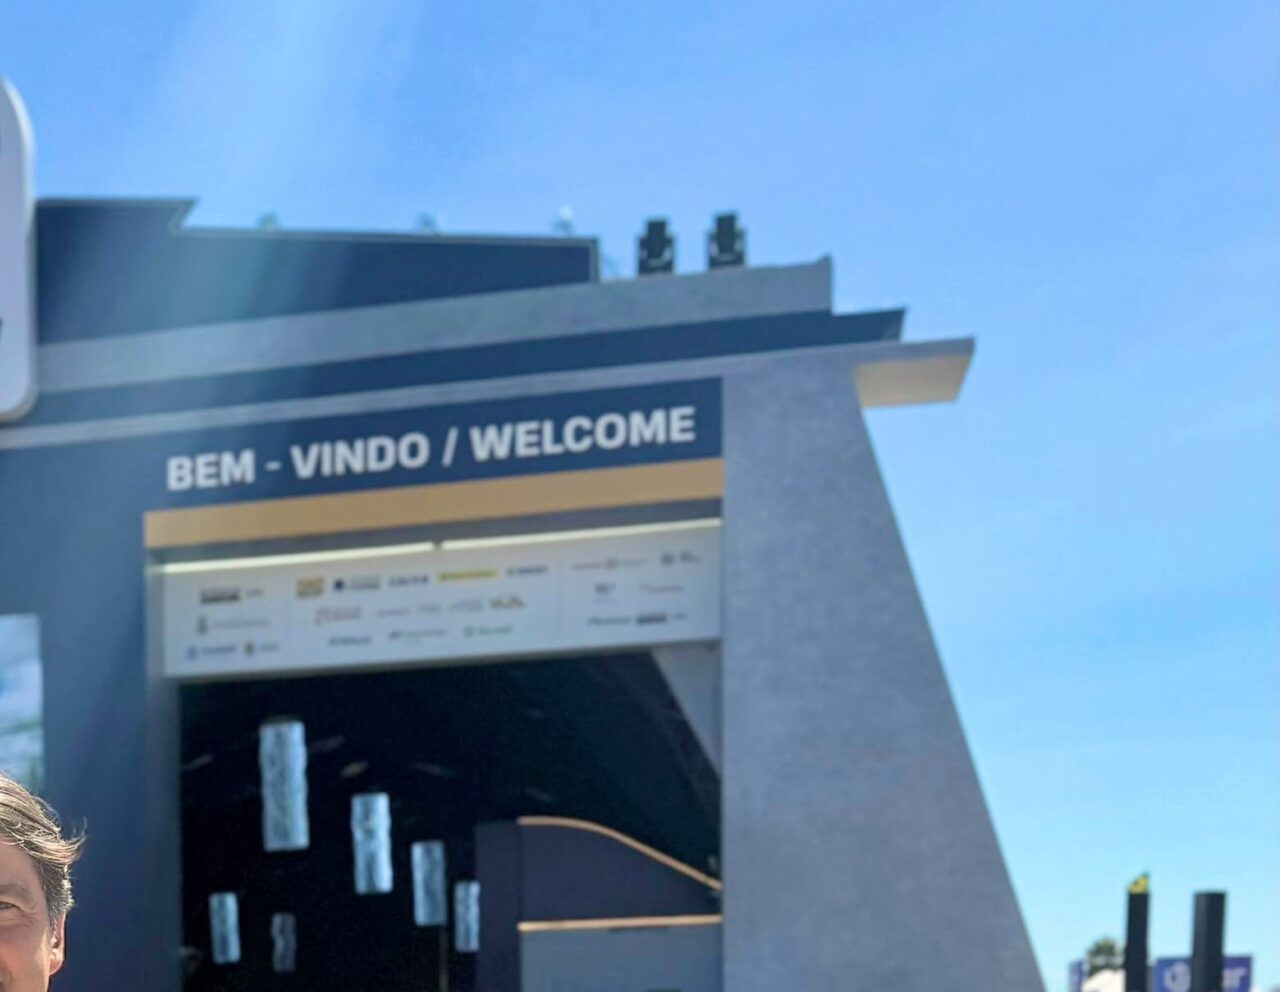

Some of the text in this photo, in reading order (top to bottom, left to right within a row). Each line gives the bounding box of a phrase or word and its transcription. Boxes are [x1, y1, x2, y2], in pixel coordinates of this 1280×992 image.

[166, 449, 255, 491] BEM
[290, 433, 429, 479] VINDO
[470, 406, 696, 462] WELCOME
